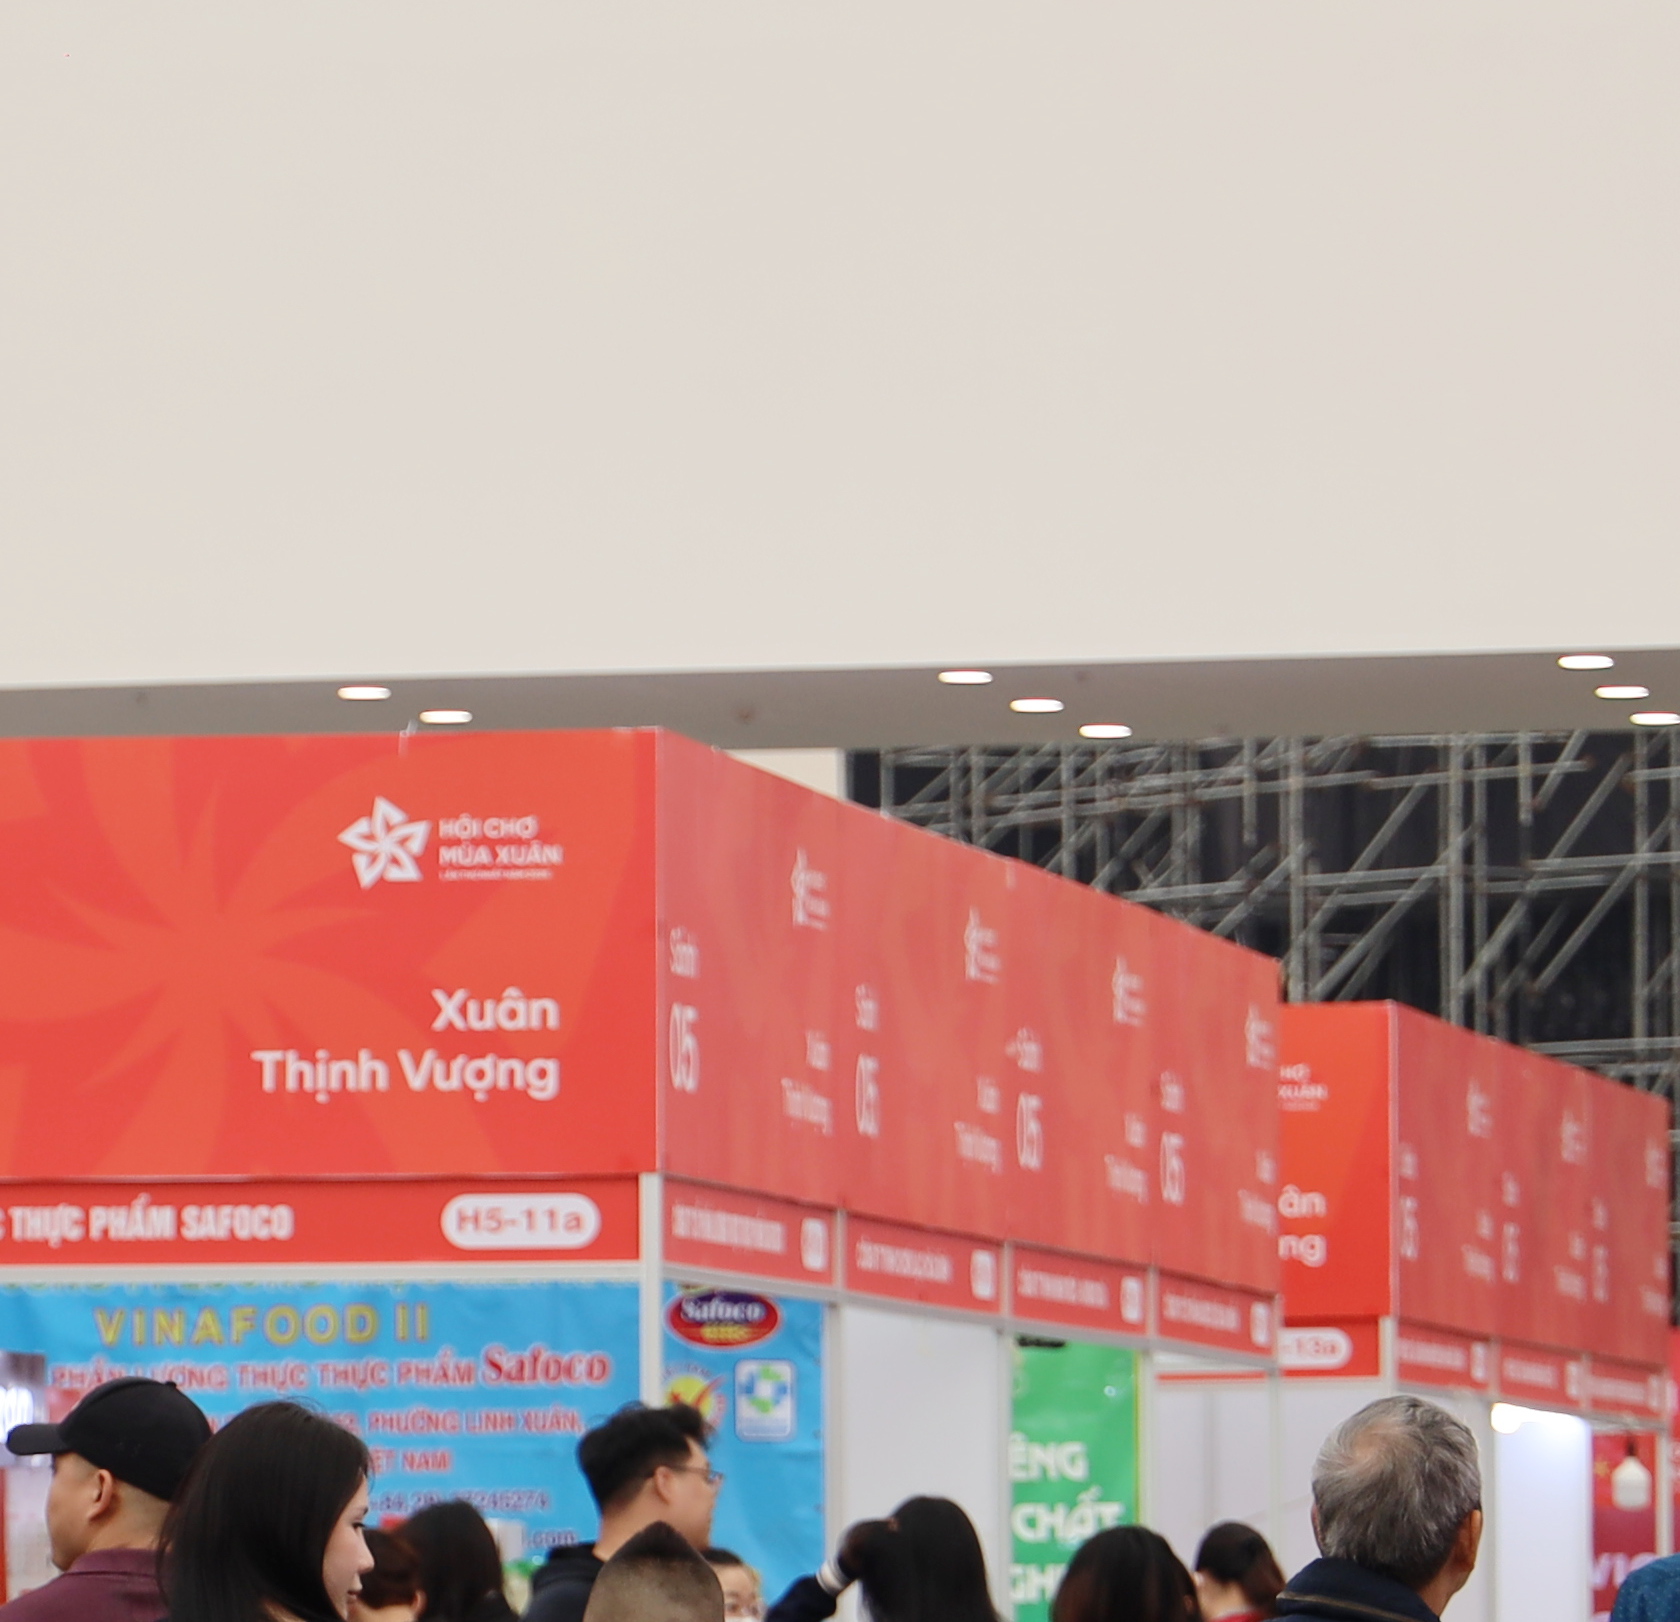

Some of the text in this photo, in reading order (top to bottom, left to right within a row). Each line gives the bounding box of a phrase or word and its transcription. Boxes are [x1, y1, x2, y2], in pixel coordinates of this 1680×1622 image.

[439, 839, 564, 867] MÙA XUÂN
[433, 987, 559, 1031] Xuân
[251, 1048, 559, 1103] Thịnh Vượng
[12, 1202, 85, 1246] THỰC
[180, 1202, 293, 1241] SAFOCO
[456, 1205, 583, 1236] H5-11a
[95, 1303, 378, 1346] VINAFOOD
[481, 1342, 612, 1386] Safoco
[401, 1450, 451, 1473] NAM
